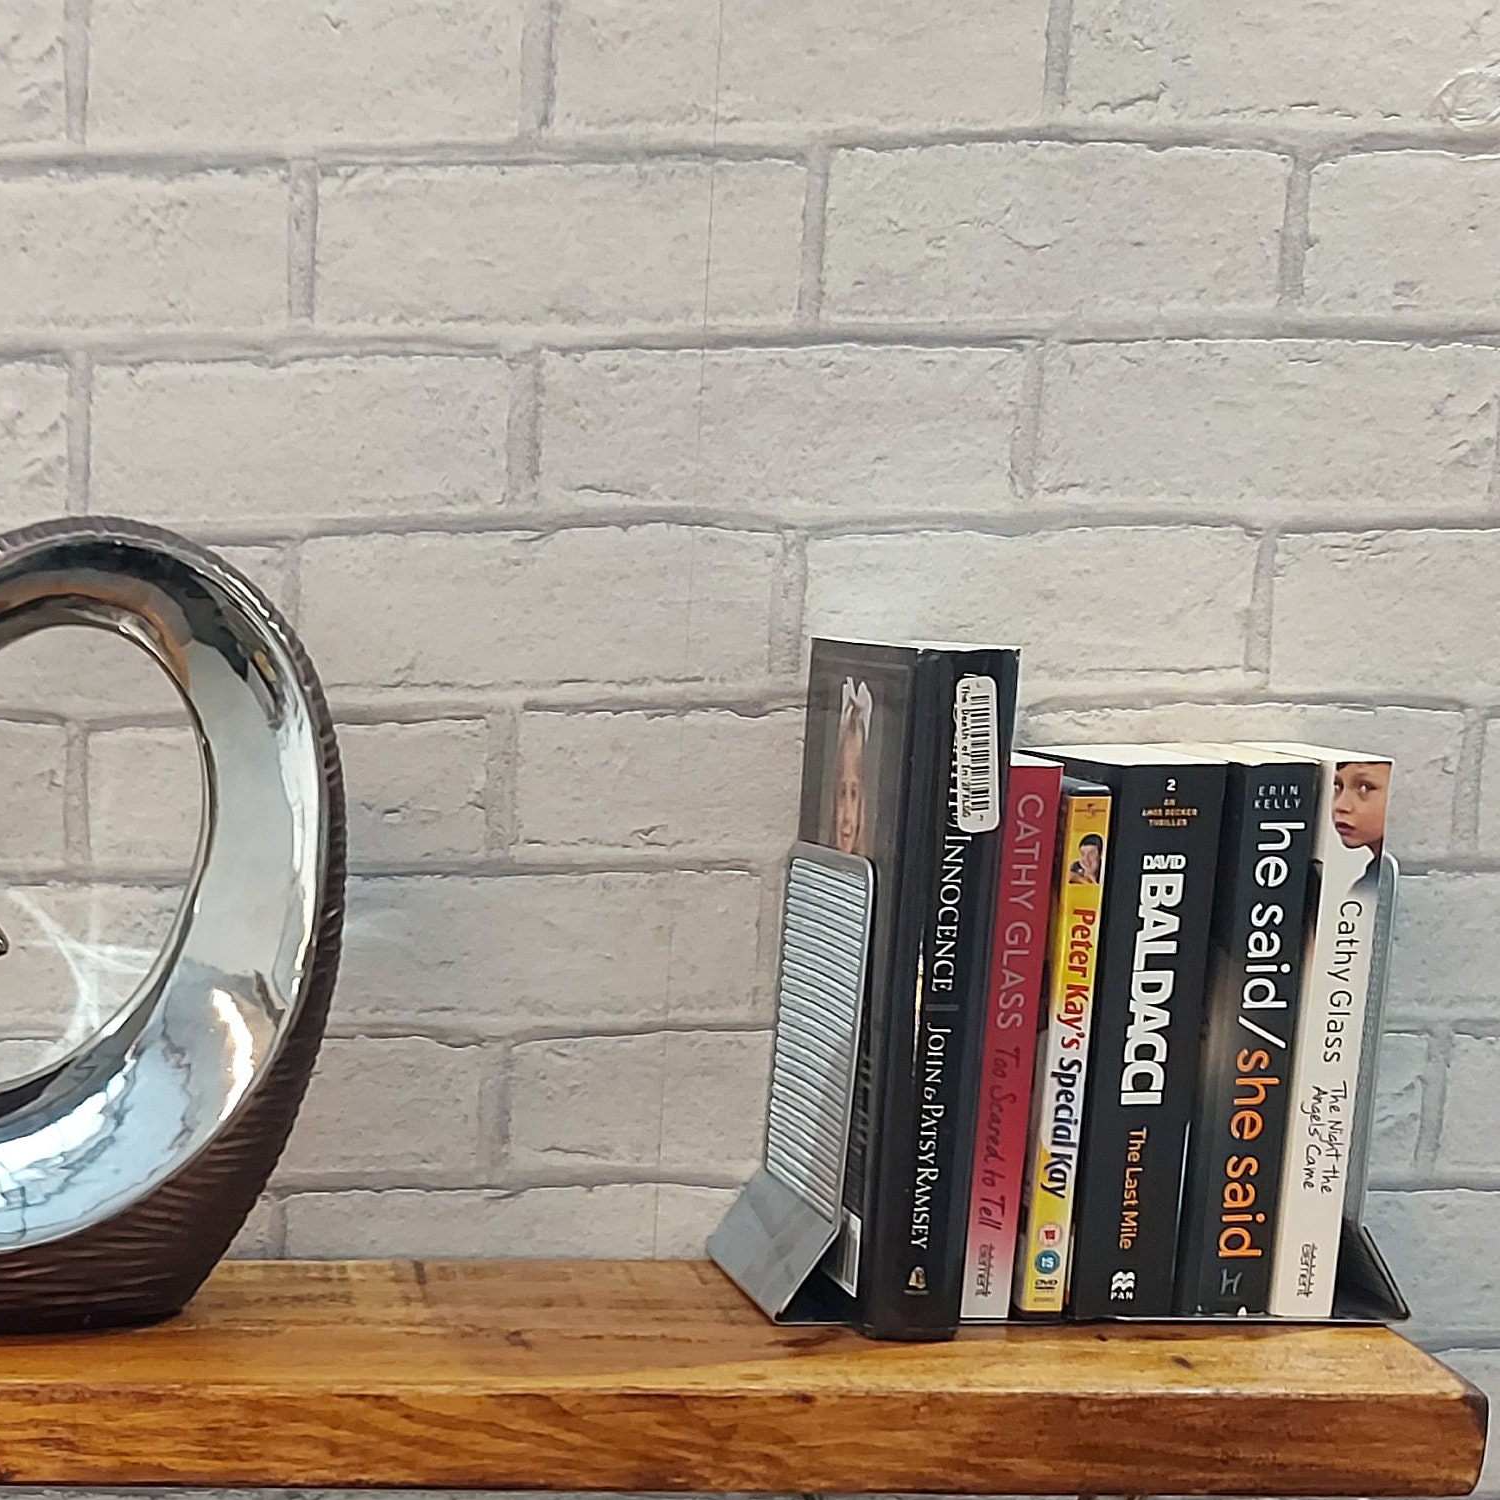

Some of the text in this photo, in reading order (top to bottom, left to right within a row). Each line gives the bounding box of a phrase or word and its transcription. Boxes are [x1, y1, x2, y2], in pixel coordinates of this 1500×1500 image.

[1166, 778, 1176, 791] 2
[1254, 798, 1301, 811] KELLY
[1258, 785, 1299, 796] ERIN
[1142, 854, 1187, 870] DAVID
[1254, 822, 1305, 888] he
[931, 834, 972, 992] INNOCENCE
[996, 793, 1045, 1029] CATHY GLASS
[1120, 873, 1185, 1105] BALDACCI
[1323, 900, 1363, 1063] Cathy Glass
[925, 1022, 952, 1084] JOHN
[1040, 908, 1096, 1199] Peter Kay's Special Kay
[917, 1104, 945, 1165] PATSY
[978, 1046, 1020, 1230] Too Scared to Tell
[1300, 1085, 1328, 1190] Angels Came
[1320, 1080, 1347, 1195] The Night the
[910, 1167, 939, 1250] RAMSEY
[1118, 1126, 1147, 1250] The Last Mile
[1217, 1155, 1267, 1259] said
[1110, 1291, 1133, 1300] PAN
